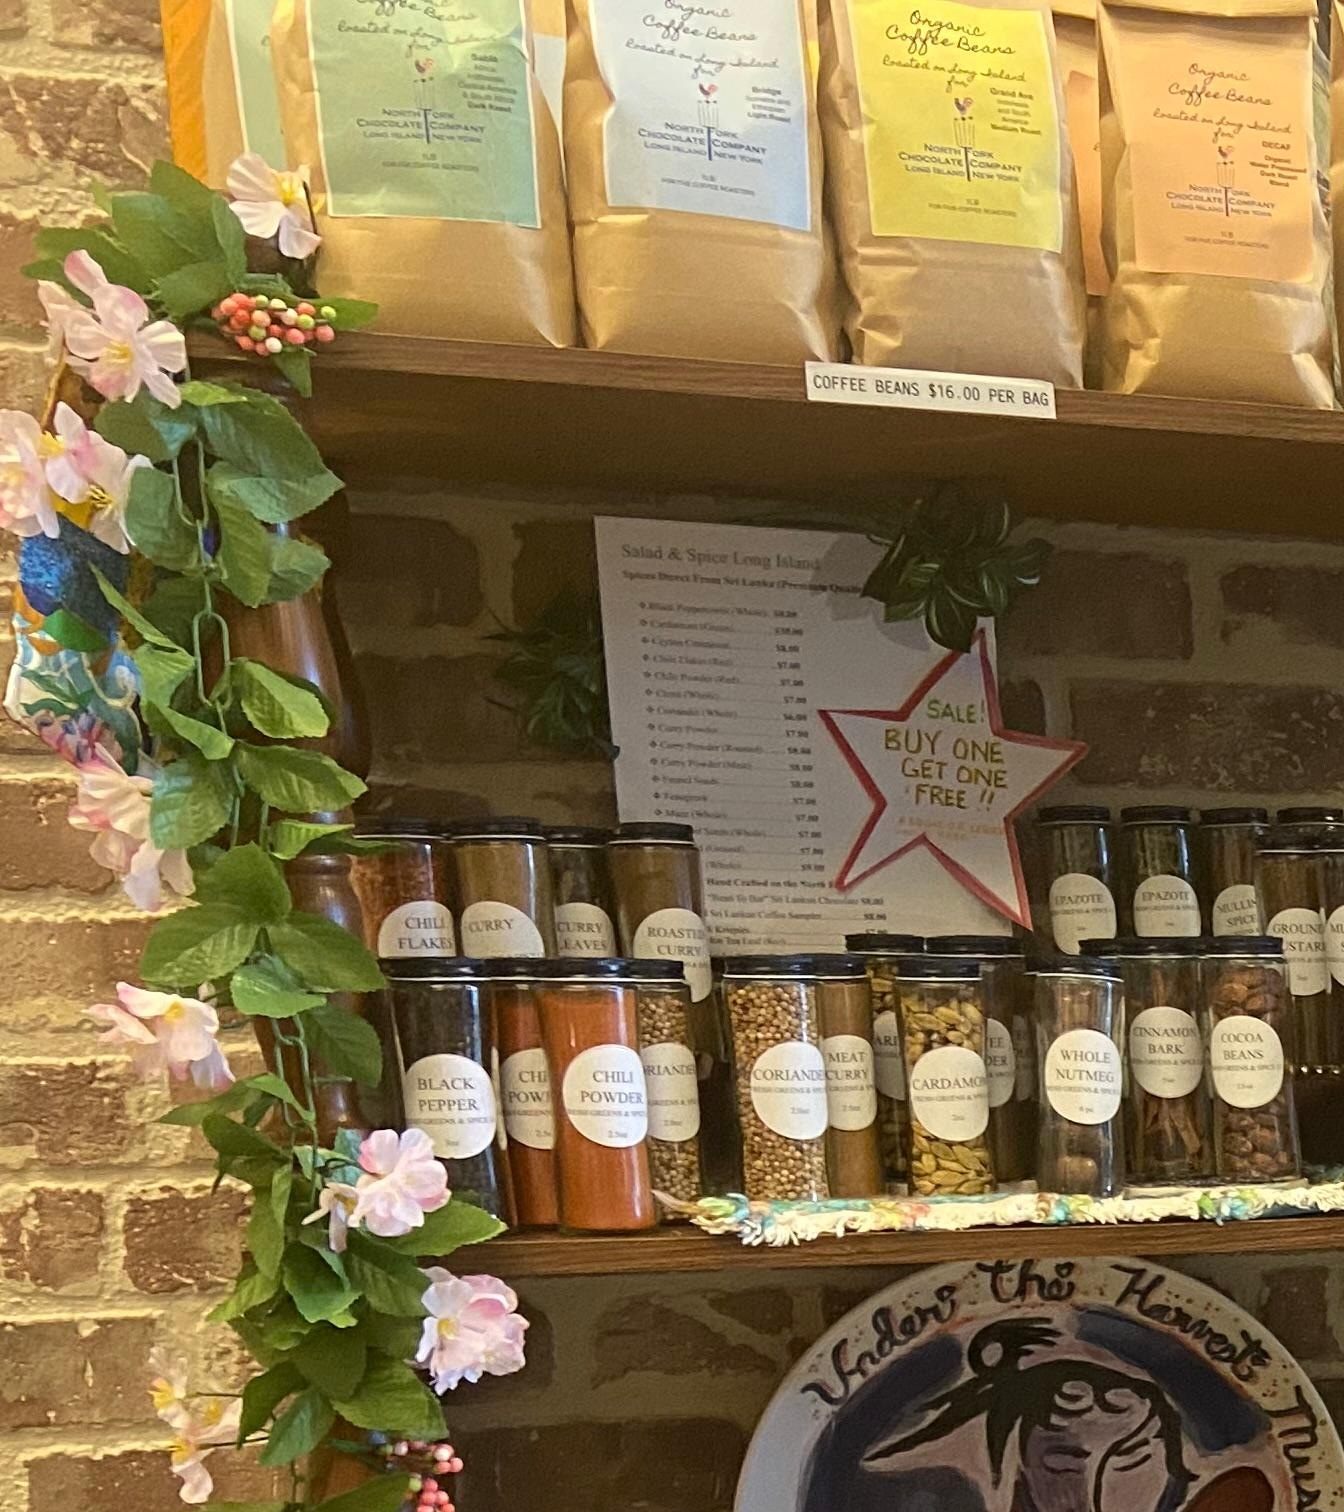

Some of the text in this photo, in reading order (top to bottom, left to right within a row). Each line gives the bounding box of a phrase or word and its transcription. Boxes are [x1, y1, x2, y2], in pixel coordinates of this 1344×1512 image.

[642, 15, 757, 41] Coffee Beans
[910, 10, 986, 36] Organic
[886, 24, 1016, 55] Coffee Beans
[625, 38, 677, 57] Roasted
[695, 53, 726, 69] Long
[729, 58, 779, 69] Island
[883, 55, 930, 71] Roasted
[947, 63, 978, 82] Long
[980, 68, 1027, 82] Island
[1189, 63, 1250, 85] Organic
[1168, 82, 1273, 106] Coffee Beans
[356, 118, 485, 134] CHOCOLATE COMPANY
[664, 121, 705, 136] NORTH
[1153, 108, 1293, 135] Roasted Long Island
[638, 128, 767, 155] CHOCOLATE COMPANY
[923, 143, 962, 157] NORTH
[898, 152, 1023, 173] CHOCOLATE COMPANY
[1188, 183, 1222, 195] NORTH
[1166, 191, 1275, 210] CHOCOLATE COMPANY
[813, 374, 1049, 406] COFFEE BEANS $16.00 PER BAG
[621, 543, 821, 571] Salad & Spice Long Island
[927, 699, 985, 724] SALE!
[884, 727, 1004, 764] BUY ONE
[901, 757, 1007, 789] GET ONE
[915, 783, 967, 809] FREE
[1055, 893, 1103, 906] EPAZOTE
[1142, 890, 1190, 902] EPAZOTE
[468, 918, 514, 934] CURRY
[557, 921, 601, 934] CURRY
[1226, 913, 1256, 927] SPICE
[647, 926, 703, 938] ROASTE
[397, 937, 454, 951] FLAKES
[656, 944, 701, 956] CURRY
[1220, 1032, 1264, 1044] COCOA
[1147, 1043, 1185, 1055] BARK
[1223, 1049, 1265, 1061] BEANS
[828, 1051, 866, 1064] MEAT
[1060, 1050, 1111, 1065] WHOLE
[592, 1069, 634, 1084] CHILI
[753, 1068, 826, 1082] CORIANDE
[826, 1068, 868, 1082] CURRY
[1055, 1068, 1115, 1084] NUTMEG
[417, 1077, 475, 1091] BLACK
[912, 1077, 987, 1092] CARDAMO
[418, 1097, 480, 1112] PEPPER
[580, 1090, 644, 1105] POWDER
[801, 1284, 957, 1406] Under
[976, 1259, 1076, 1303] the
[1111, 1264, 1272, 1383] Harvest
